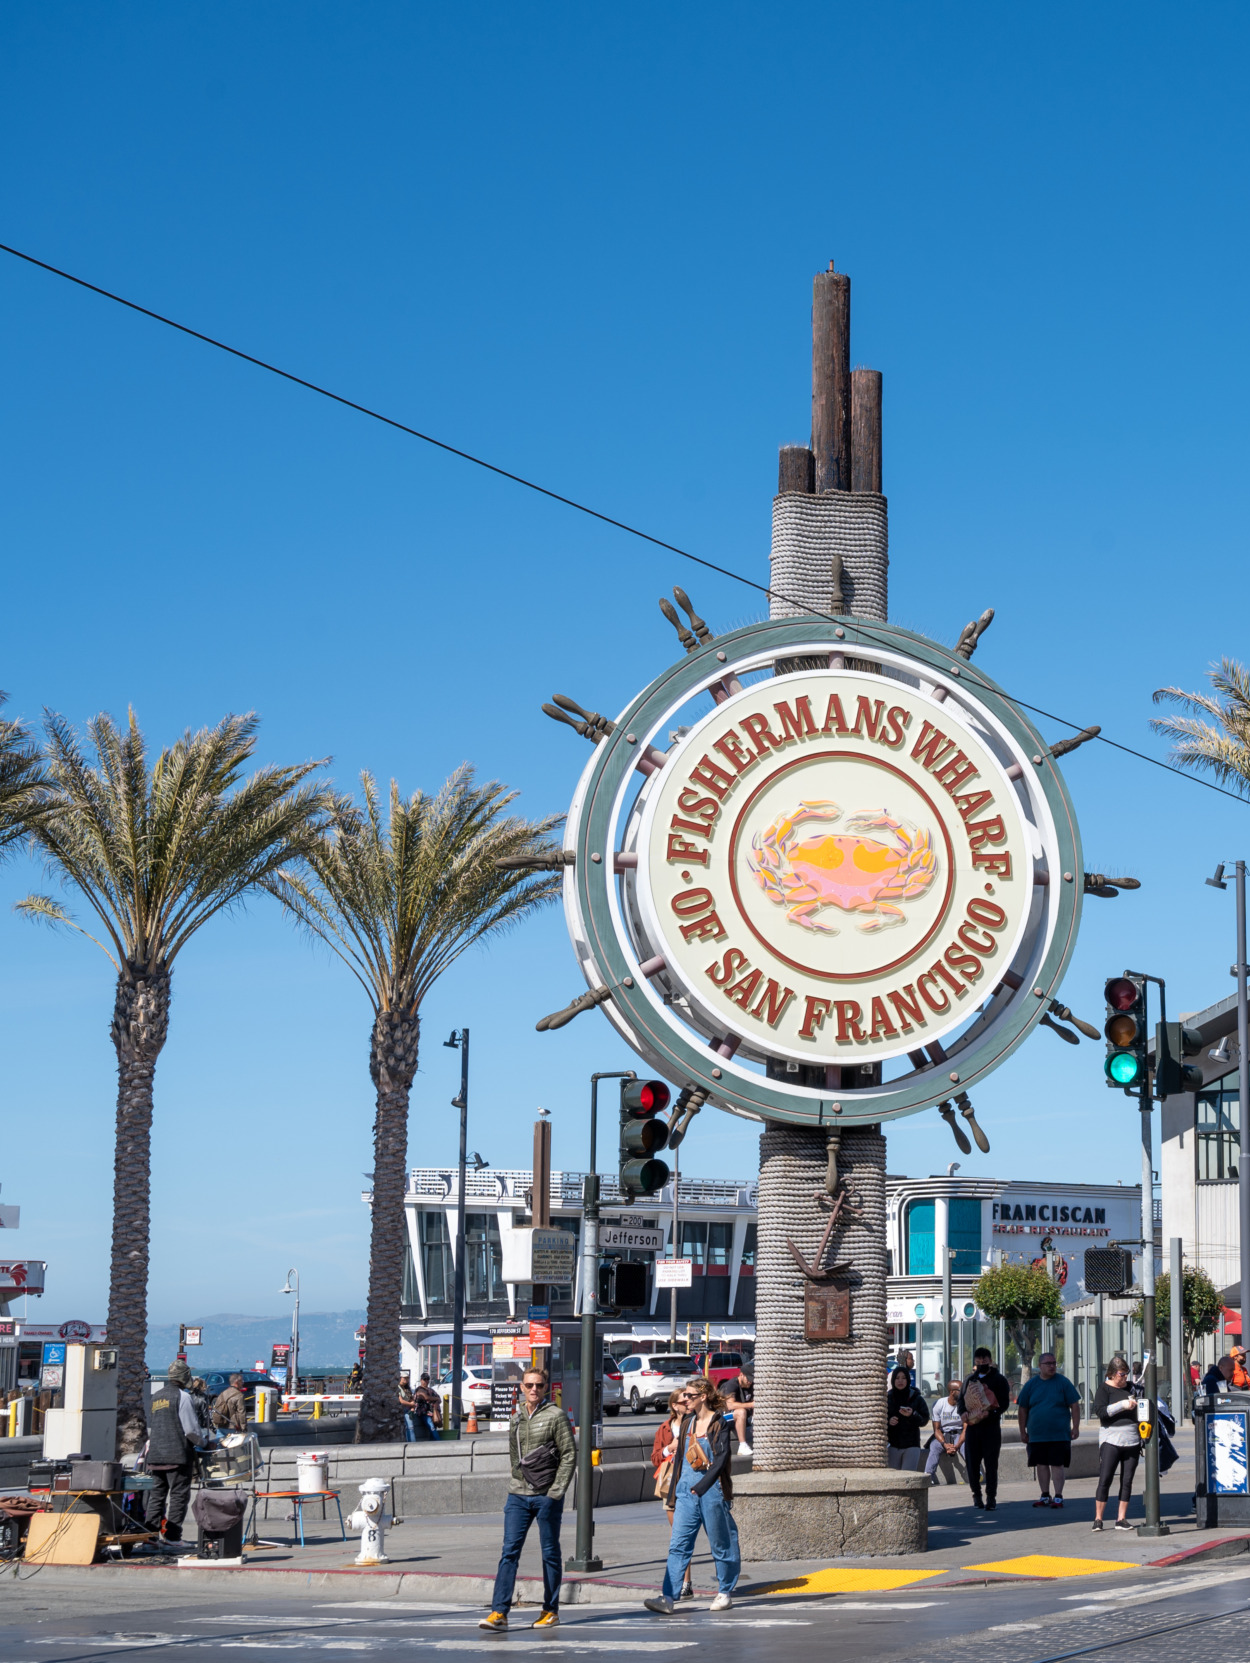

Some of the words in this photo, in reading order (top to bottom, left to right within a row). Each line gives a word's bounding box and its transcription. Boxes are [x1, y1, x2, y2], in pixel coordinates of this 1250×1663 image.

[666, 693, 913, 865] FISHERMANS
[909, 719, 1014, 881] WHARF
[671, 886, 727, 944] OF
[705, 946, 796, 1028] SAN
[797, 896, 1008, 1044] FRANCISCO
[992, 1203, 1106, 1224] FRANCISCAN
[628, 1216, 642, 1226] 200
[604, 1230, 658, 1246] Jefferson
[1030, 1225, 1111, 1237] RESTAURANT
[537, 1237, 569, 1245] PARKING
[368, 1529, 377, 1542] 8
